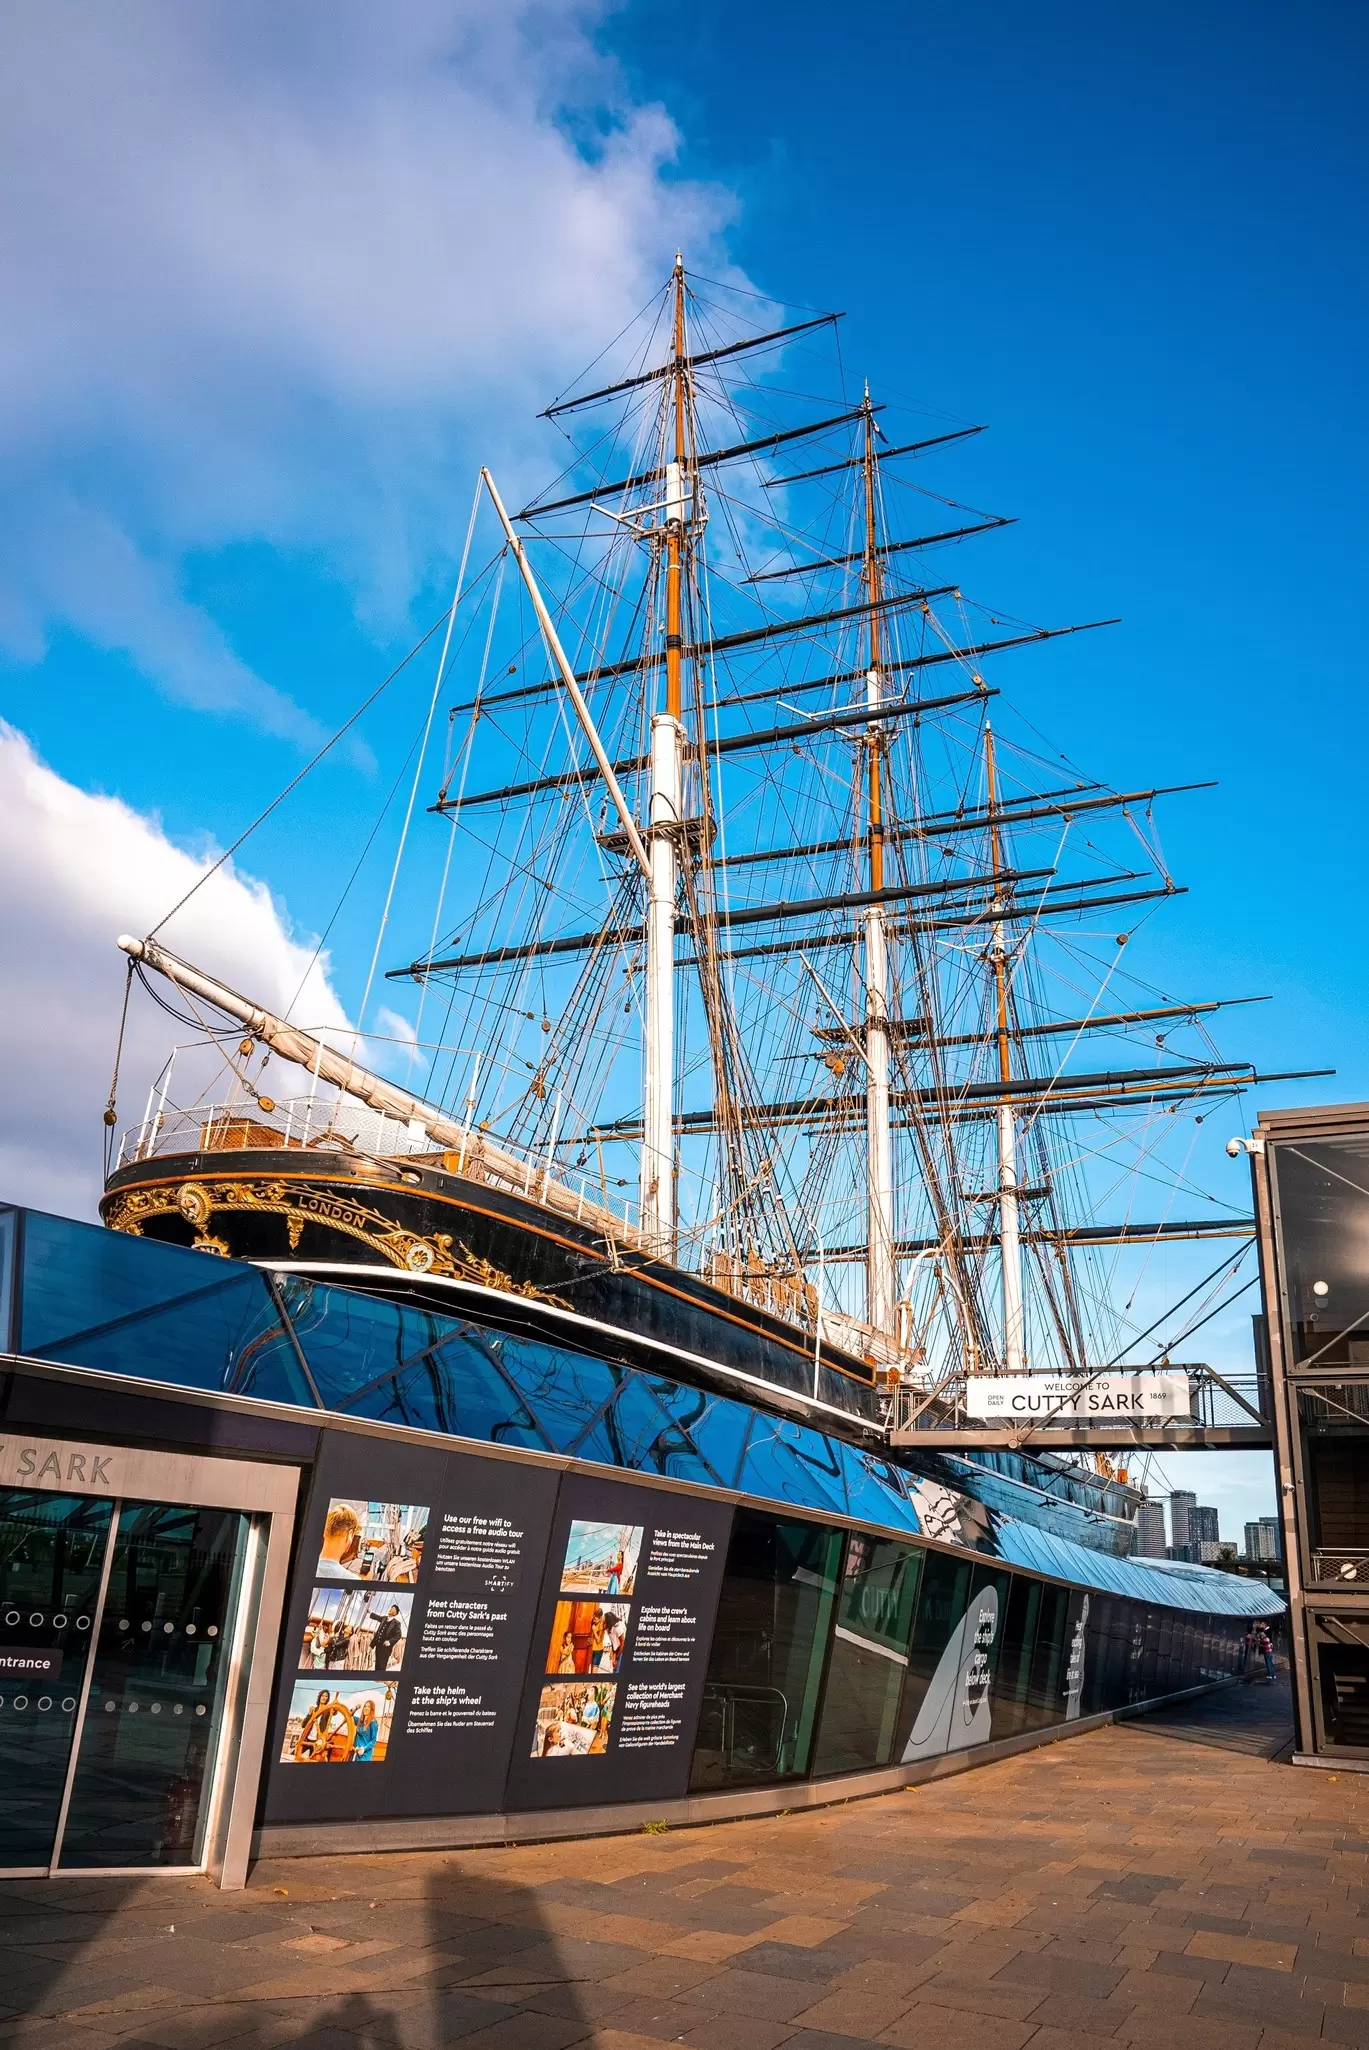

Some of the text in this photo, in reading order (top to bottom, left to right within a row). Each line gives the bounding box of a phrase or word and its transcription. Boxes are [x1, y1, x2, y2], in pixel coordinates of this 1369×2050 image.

[299, 1196, 365, 1228] LONDON
[1044, 1382, 1094, 1391] WELCOME
[1012, 1393, 1144, 1410] CUTTY SARK
[17, 1448, 113, 1484] SARK
[444, 1514, 457, 1523] Use
[473, 1516, 487, 1526] free
[489, 1518, 502, 1527] wifi
[442, 1525, 466, 1534] access
[473, 1526, 487, 1535] free
[488, 1528, 507, 1536] audio
[654, 1530, 666, 1538] Take
[653, 1538, 667, 1546] views
[429, 1600, 488, 1610] Meet characters
[427, 1609, 444, 1618] from
[446, 1610, 467, 1620] Cutty
[469, 1611, 490, 1619] Sark's
[641, 1606, 660, 1615] Explore
[414, 1686, 431, 1694] Take
[447, 1686, 465, 1694] helm
[668, 1683, 685, 1691] largest
[422, 1696, 434, 1704] the
[436, 1696, 457, 1706] ship's
[459, 1696, 481, 1704] wheel
[625, 1700, 670, 1710] Navy figureheads
